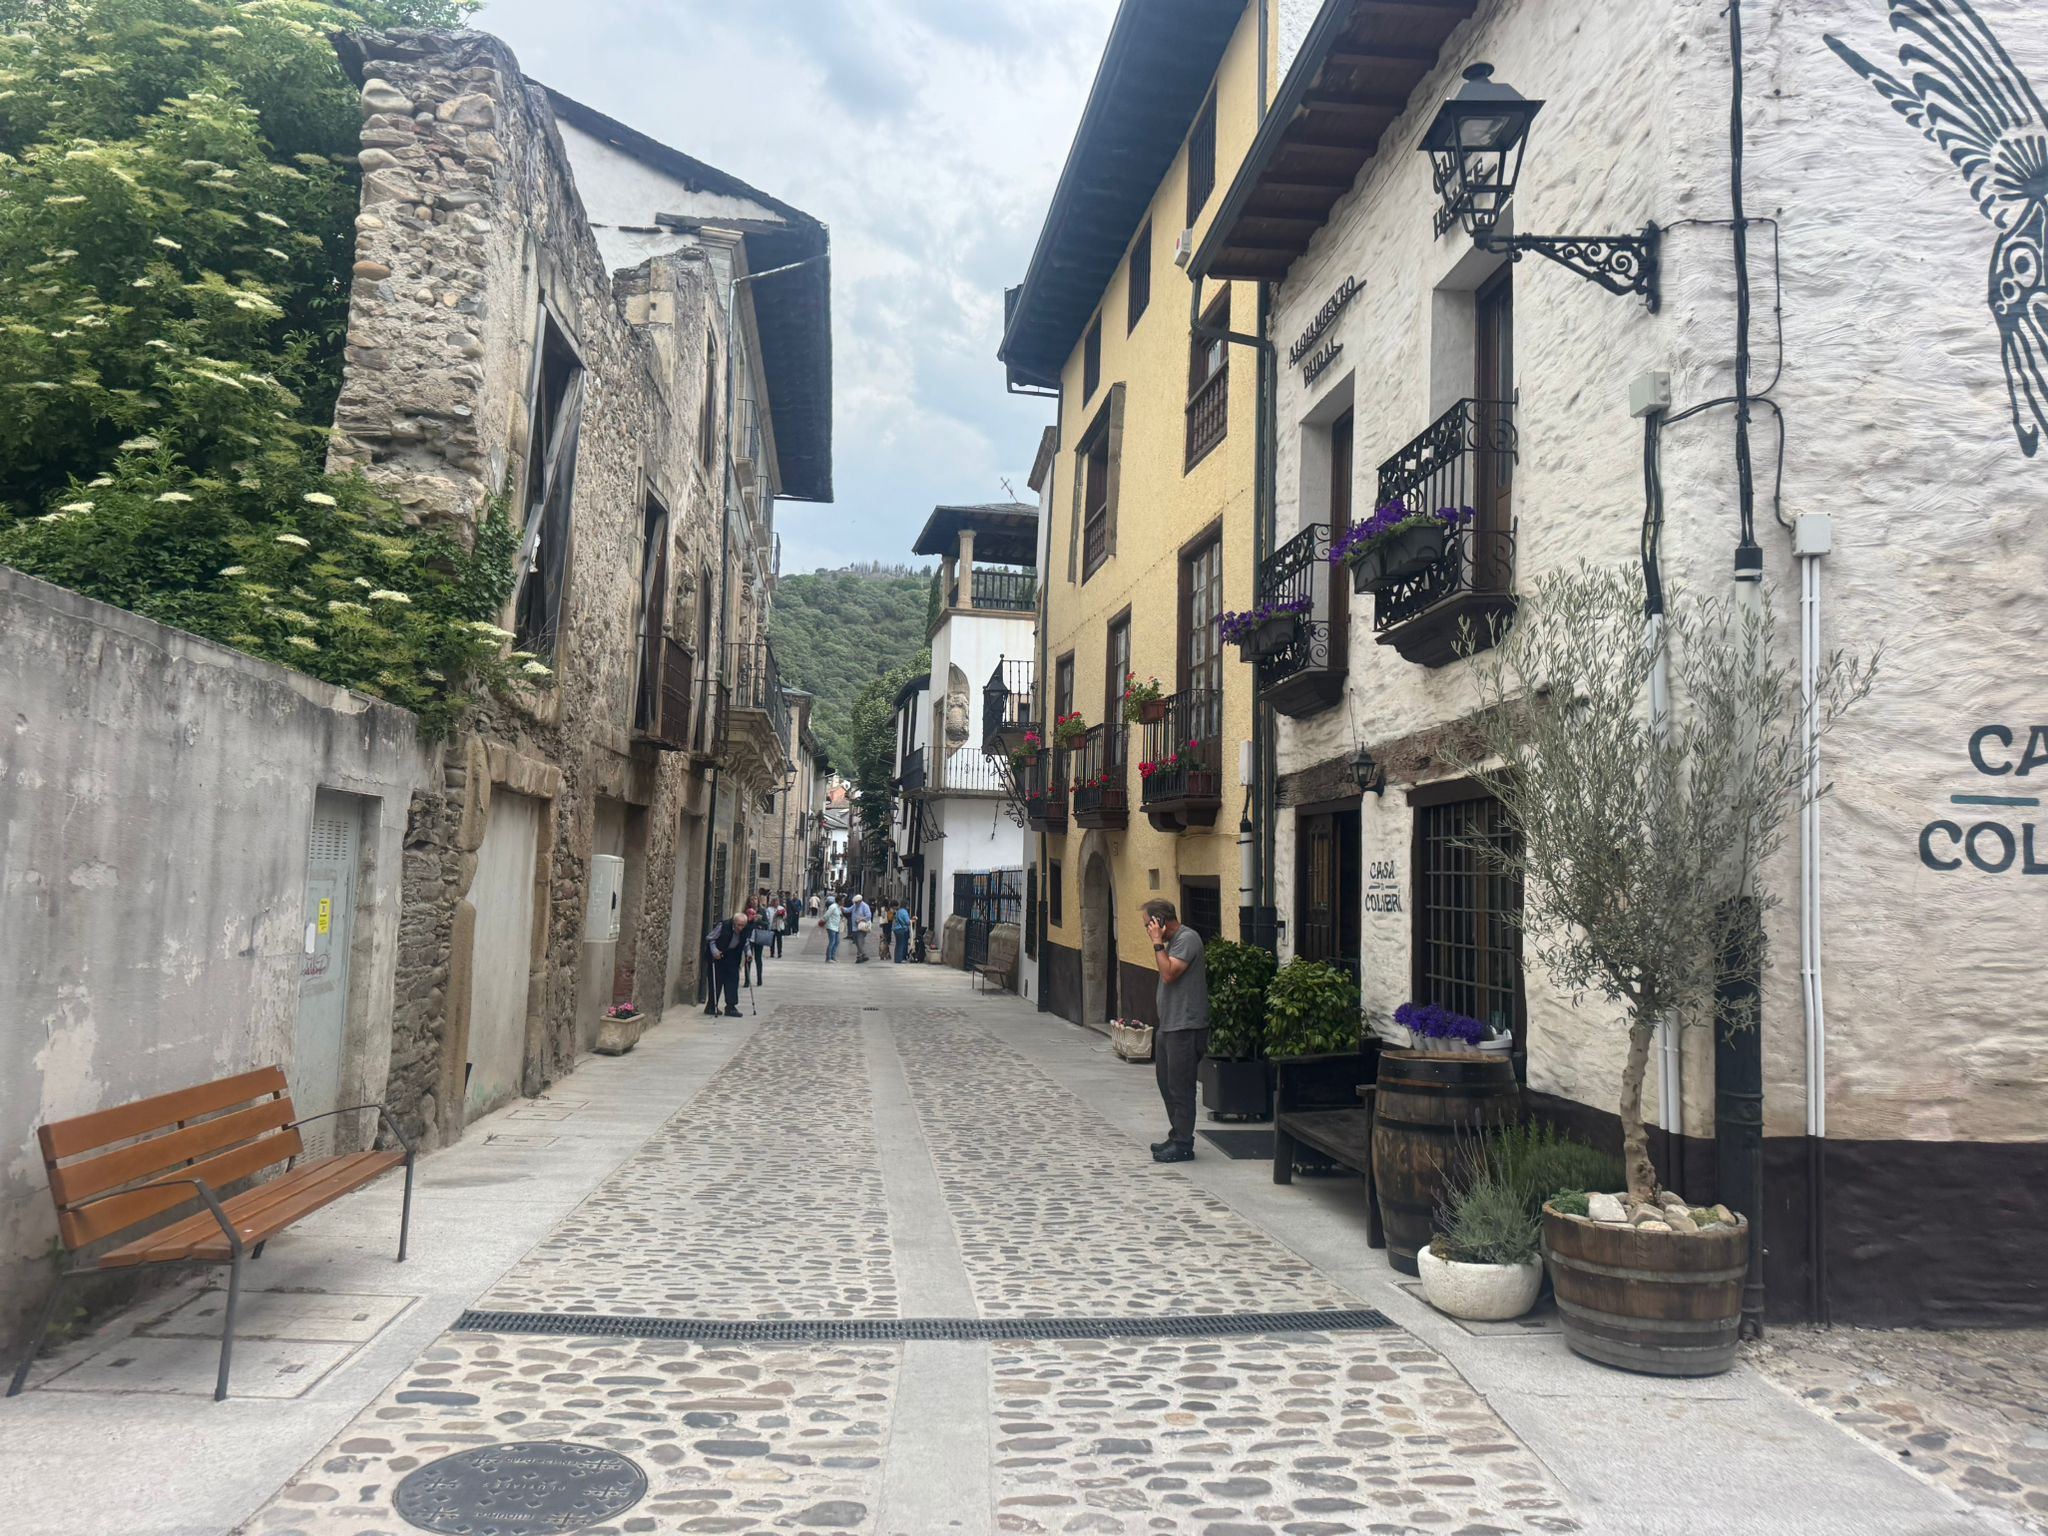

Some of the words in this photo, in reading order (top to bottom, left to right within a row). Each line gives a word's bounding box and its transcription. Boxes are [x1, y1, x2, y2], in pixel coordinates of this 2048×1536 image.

[1288, 274, 1366, 370] ALOJAMIENTO
[1303, 336, 1344, 389] RURAL
[1370, 860, 1395, 879] CASA
